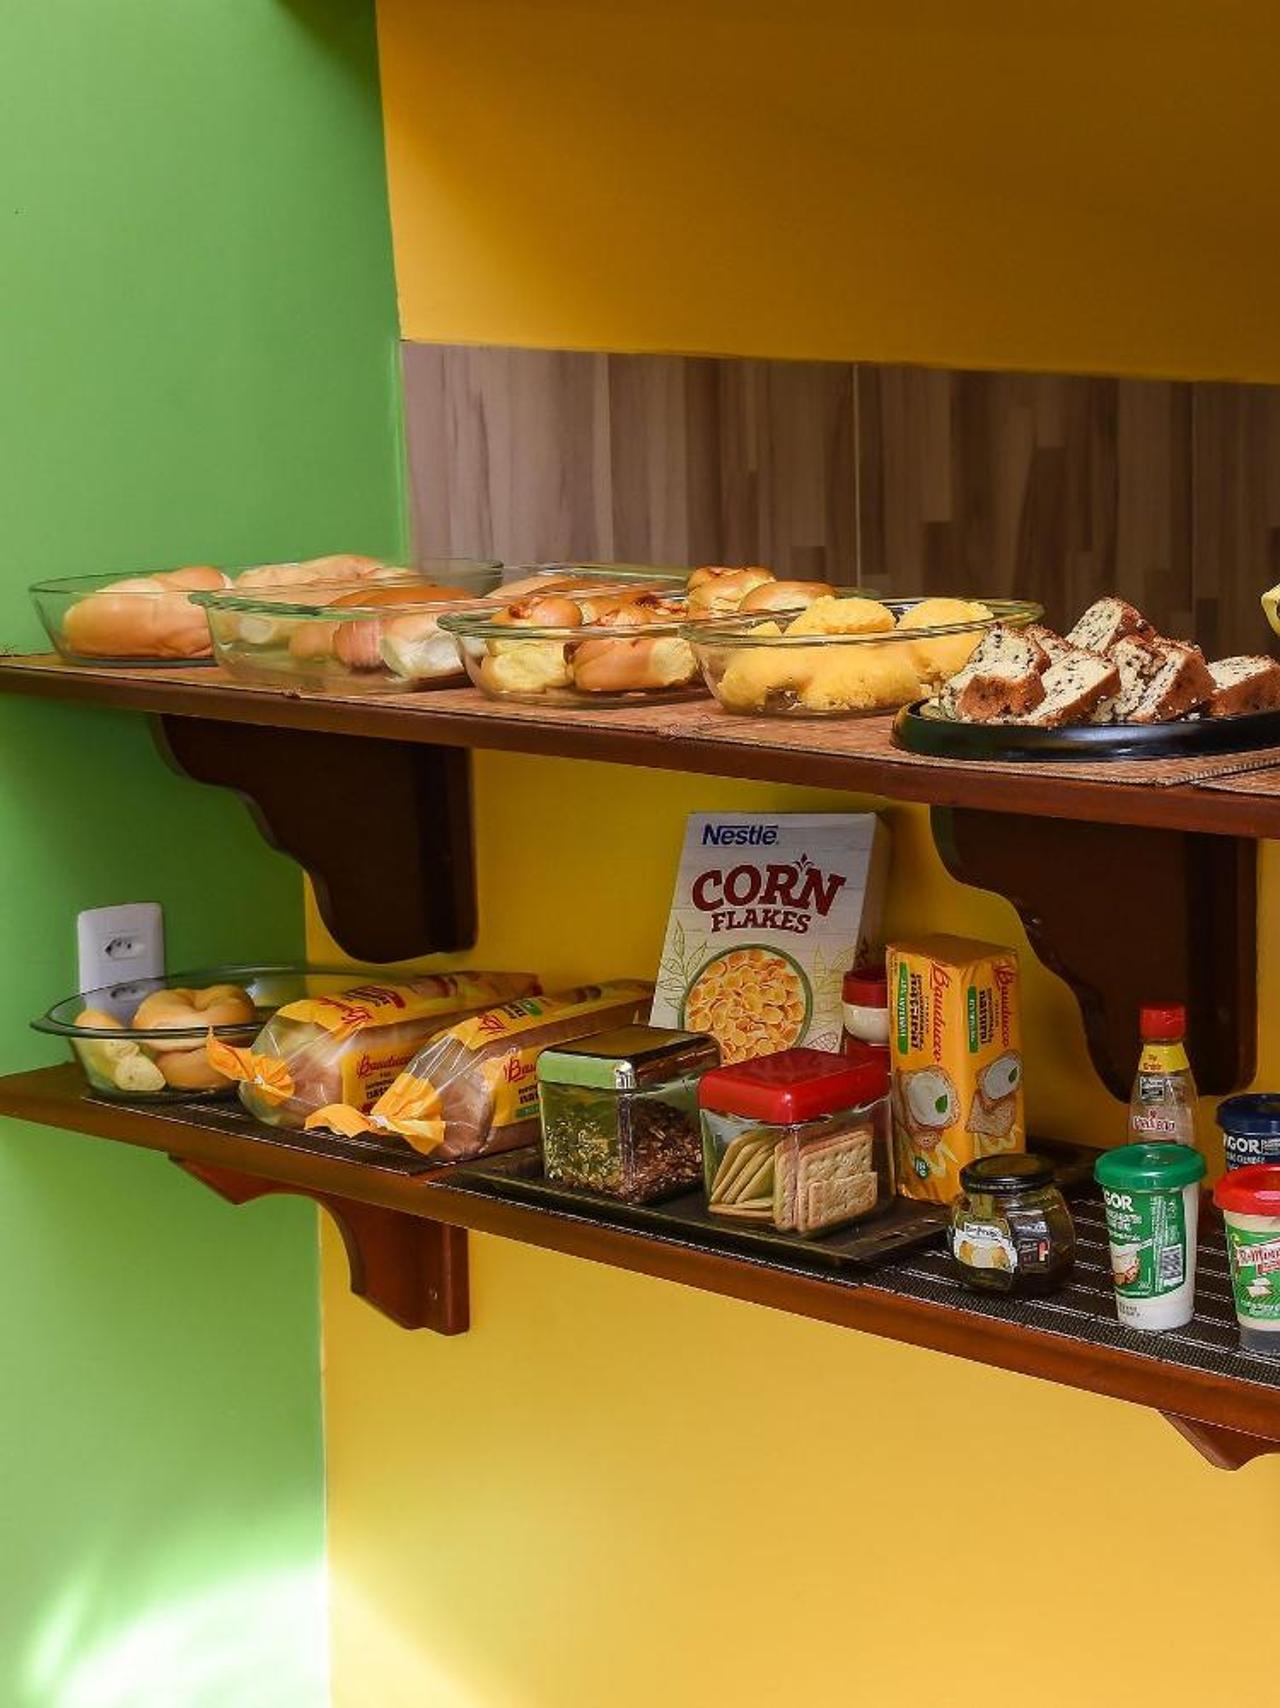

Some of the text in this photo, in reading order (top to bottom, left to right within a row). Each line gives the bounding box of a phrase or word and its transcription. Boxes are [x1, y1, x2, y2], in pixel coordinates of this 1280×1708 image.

[692, 864, 847, 917] CORN
[711, 908, 812, 934] FLAKES
[930, 962, 952, 1062] Bauducco
